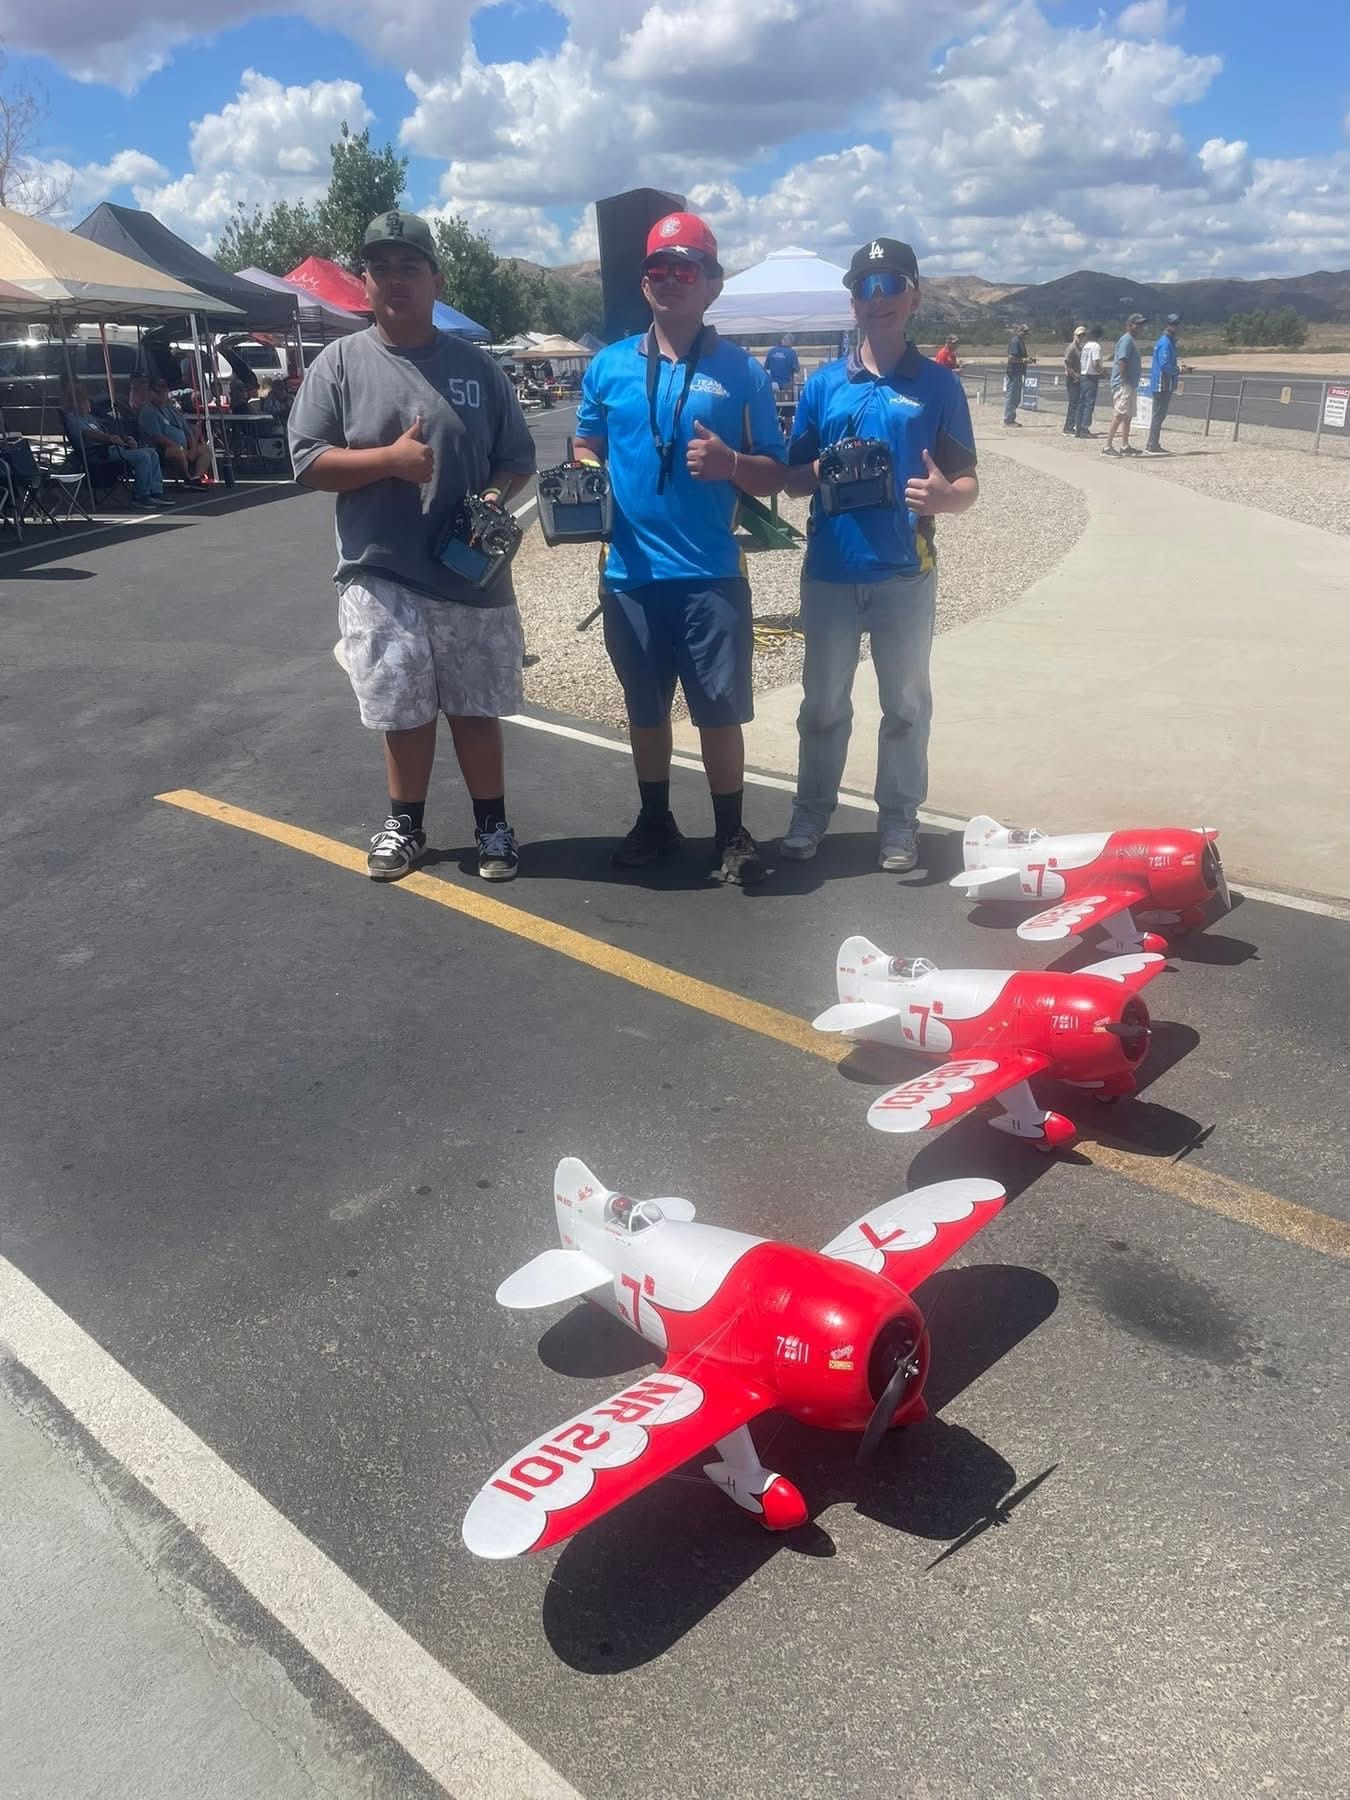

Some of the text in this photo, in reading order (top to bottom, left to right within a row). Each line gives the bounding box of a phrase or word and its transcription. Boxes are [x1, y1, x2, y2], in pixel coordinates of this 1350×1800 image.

[868, 241, 884, 259] LA
[449, 378, 480, 408] 50
[1027, 863, 1046, 897] 7
[908, 1003, 931, 1049] 7
[1051, 1015, 1060, 1030] 7
[621, 1272, 644, 1334] 7
[776, 1335, 786, 1357] 7
[798, 1342, 810, 1365] 11
